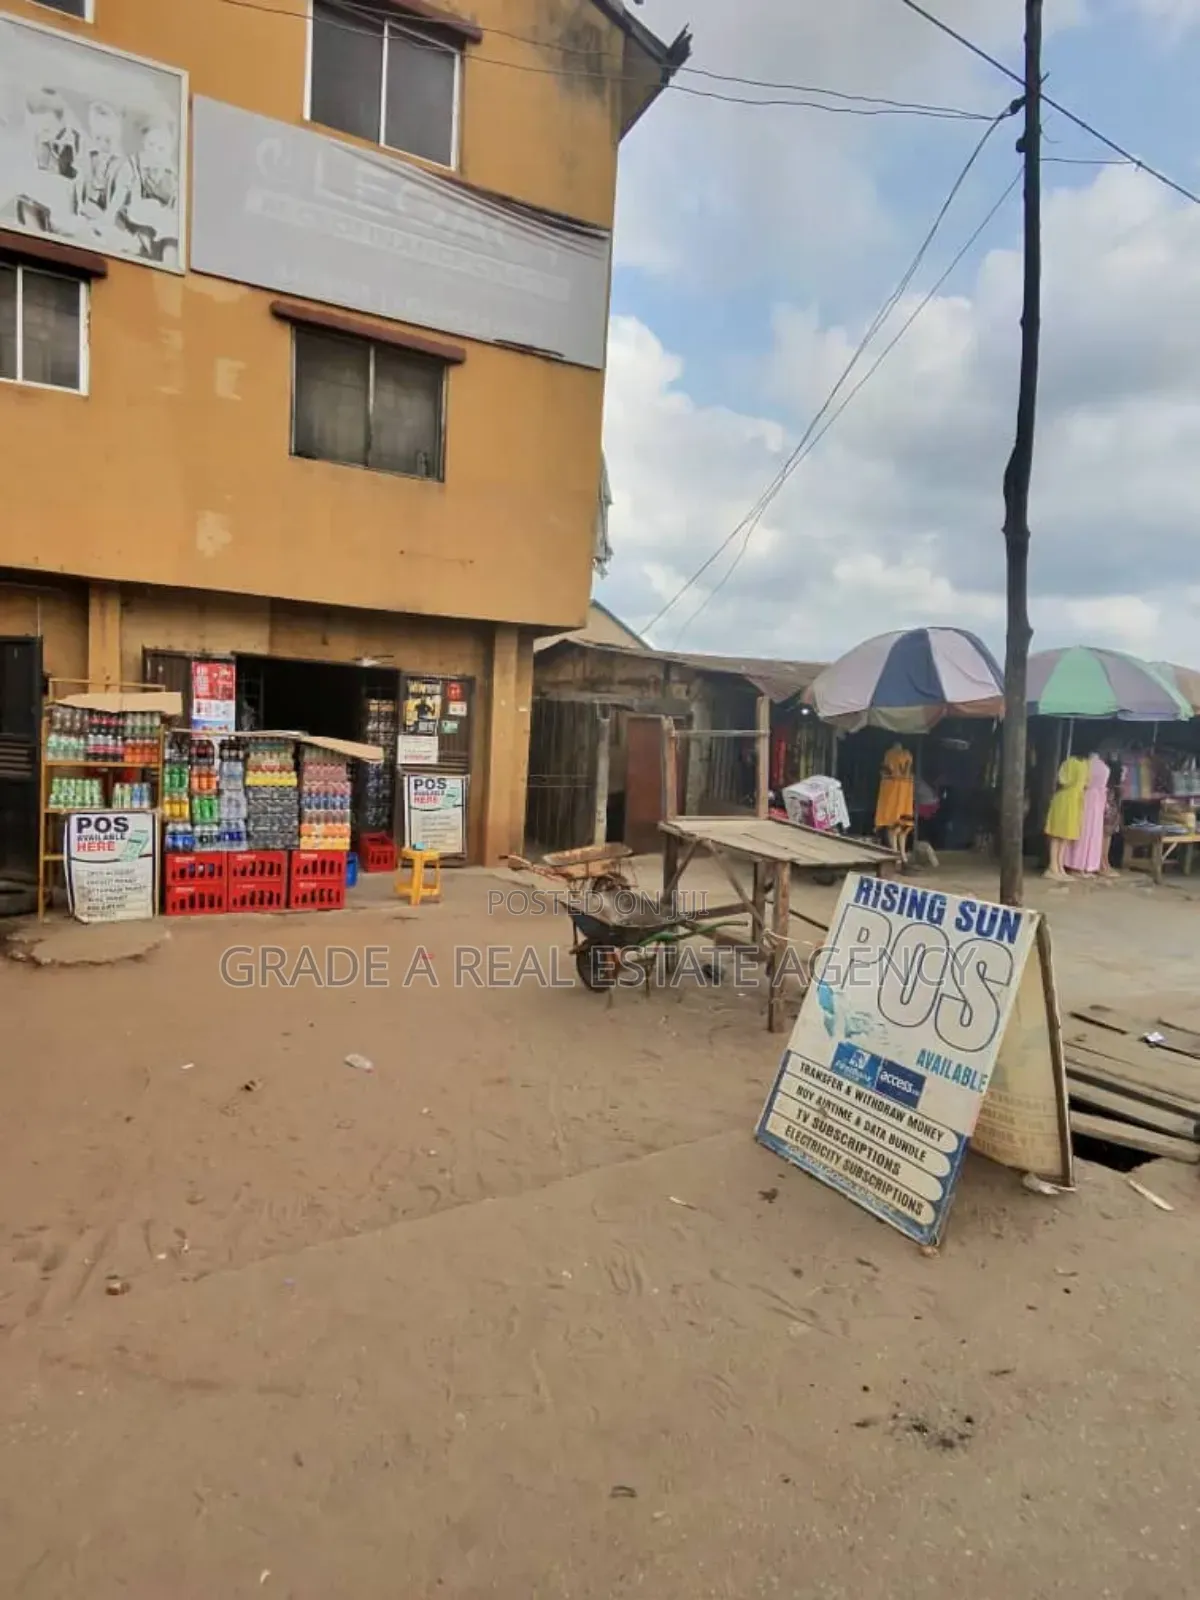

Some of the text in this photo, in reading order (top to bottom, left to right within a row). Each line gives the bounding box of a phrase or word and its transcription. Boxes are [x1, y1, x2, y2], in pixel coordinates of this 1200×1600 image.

[413, 778, 447, 790] POS
[76, 816, 129, 834] POS
[76, 832, 126, 842] AVAILABLE
[76, 841, 115, 853] HERE
[854, 876, 1022, 945] RISING SUN
[817, 902, 1014, 1053] POS
[880, 1069, 913, 1093] access
[916, 1048, 989, 1093] AVAILABLE
[796, 1085, 812, 1102] BUY
[815, 1095, 853, 1122] AIRTIME
[863, 1120, 887, 1141] DATA
[888, 1133, 927, 1163] BUNDLE
[800, 1063, 847, 1094] TRANSFER
[854, 1088, 906, 1122] WITHDRAW
[907, 1114, 945, 1143] MONEY
[785, 1124, 842, 1166] ELECTRICITY
[842, 1160, 924, 1217] SUBSCRIPTIONS
[796, 1109, 901, 1176] TV SUBSCRIPTIONS
